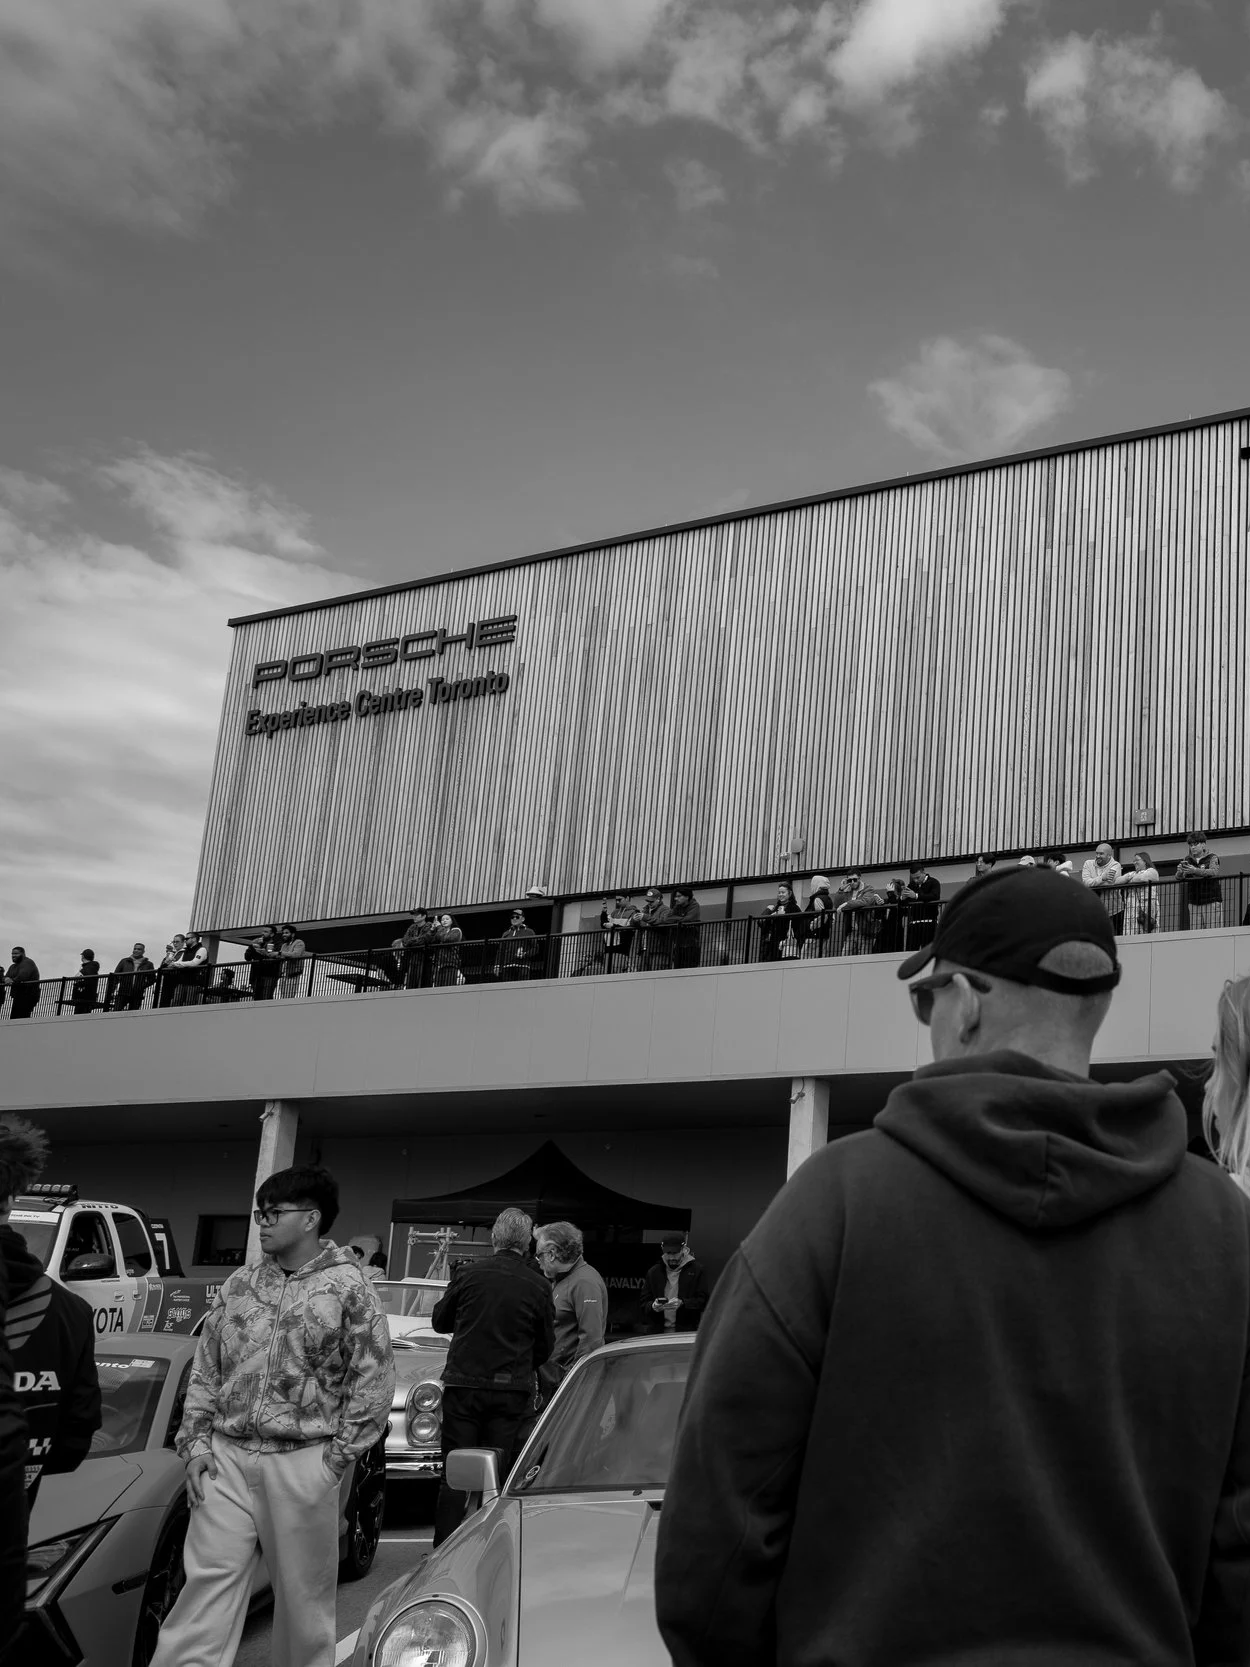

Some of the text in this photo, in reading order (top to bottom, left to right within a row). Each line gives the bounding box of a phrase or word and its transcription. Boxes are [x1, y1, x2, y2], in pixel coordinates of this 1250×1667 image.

[252, 615, 517, 688] PORSCHE
[245, 670, 510, 738] Experience Centre Toronto
[93, 1307, 124, 1334] OTA
[13, 1370, 61, 1392] DA
